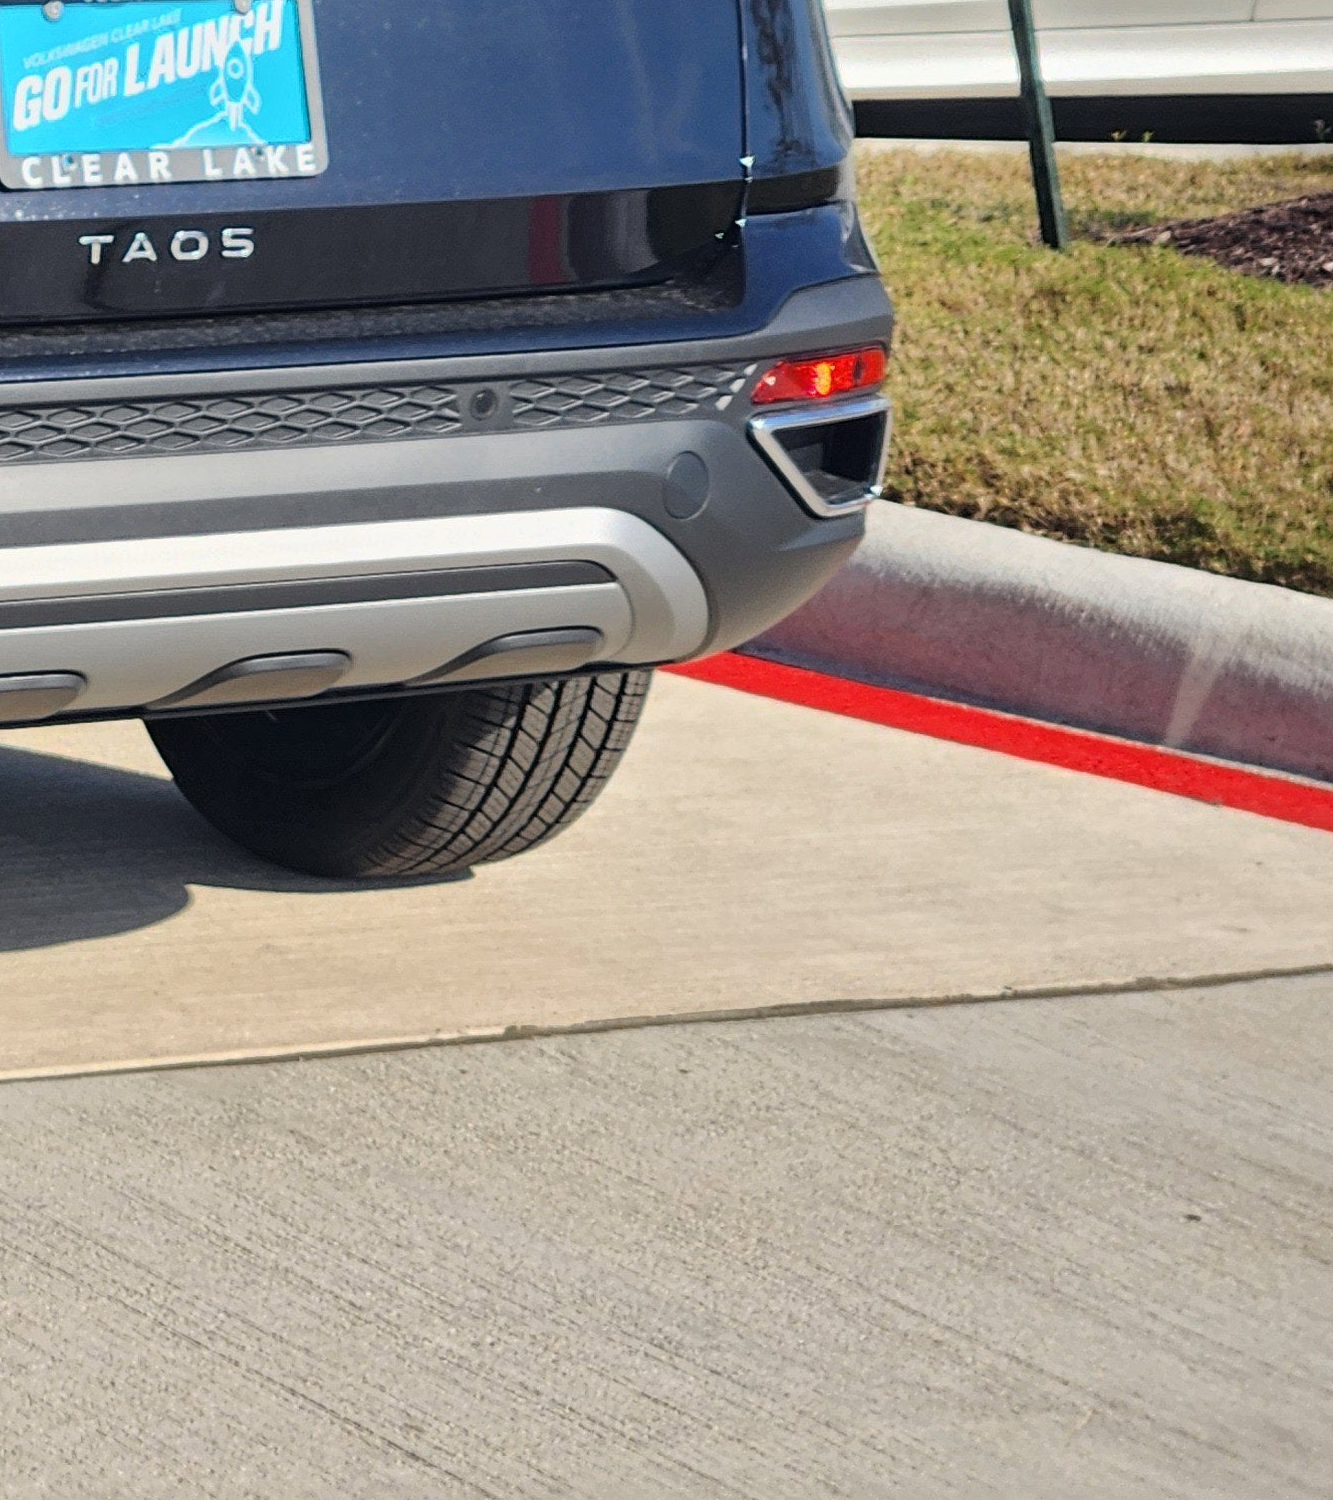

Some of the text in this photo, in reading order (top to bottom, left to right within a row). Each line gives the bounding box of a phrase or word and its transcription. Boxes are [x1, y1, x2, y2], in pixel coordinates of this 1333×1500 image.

[23, 8, 182, 69] VOLKSWAGEN CLEAR LAKE
[13, 66, 71, 132] GO
[74, 57, 118, 108] FOR
[21, 143, 317, 188] CLEAR LAKE
[78, 228, 255, 265] TAOS
